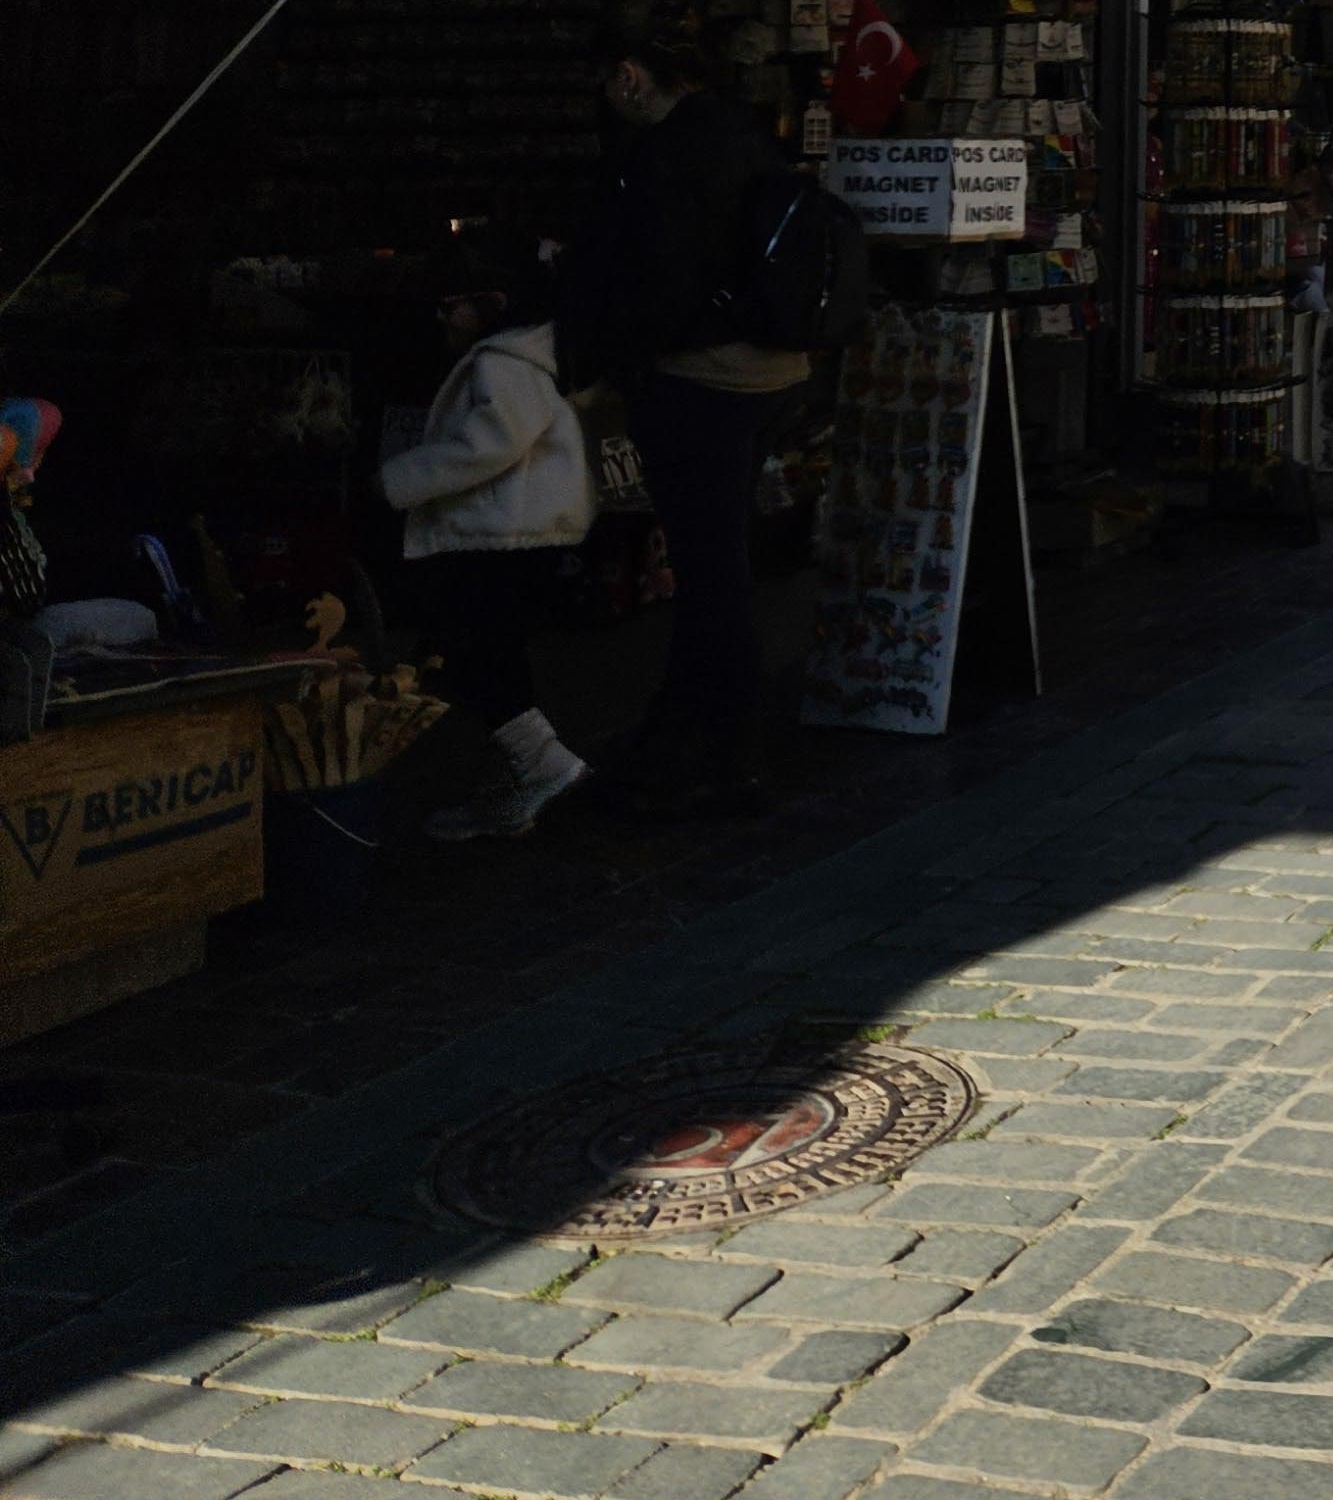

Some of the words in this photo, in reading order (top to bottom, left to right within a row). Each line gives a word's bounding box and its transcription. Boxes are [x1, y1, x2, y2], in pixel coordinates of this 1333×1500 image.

[837, 146, 880, 163] POS
[887, 146, 948, 163] CARD
[952, 147, 982, 163] POS
[989, 147, 1024, 163] CARD
[843, 177, 939, 193] MAGNET
[958, 177, 1020, 193] MAGNET
